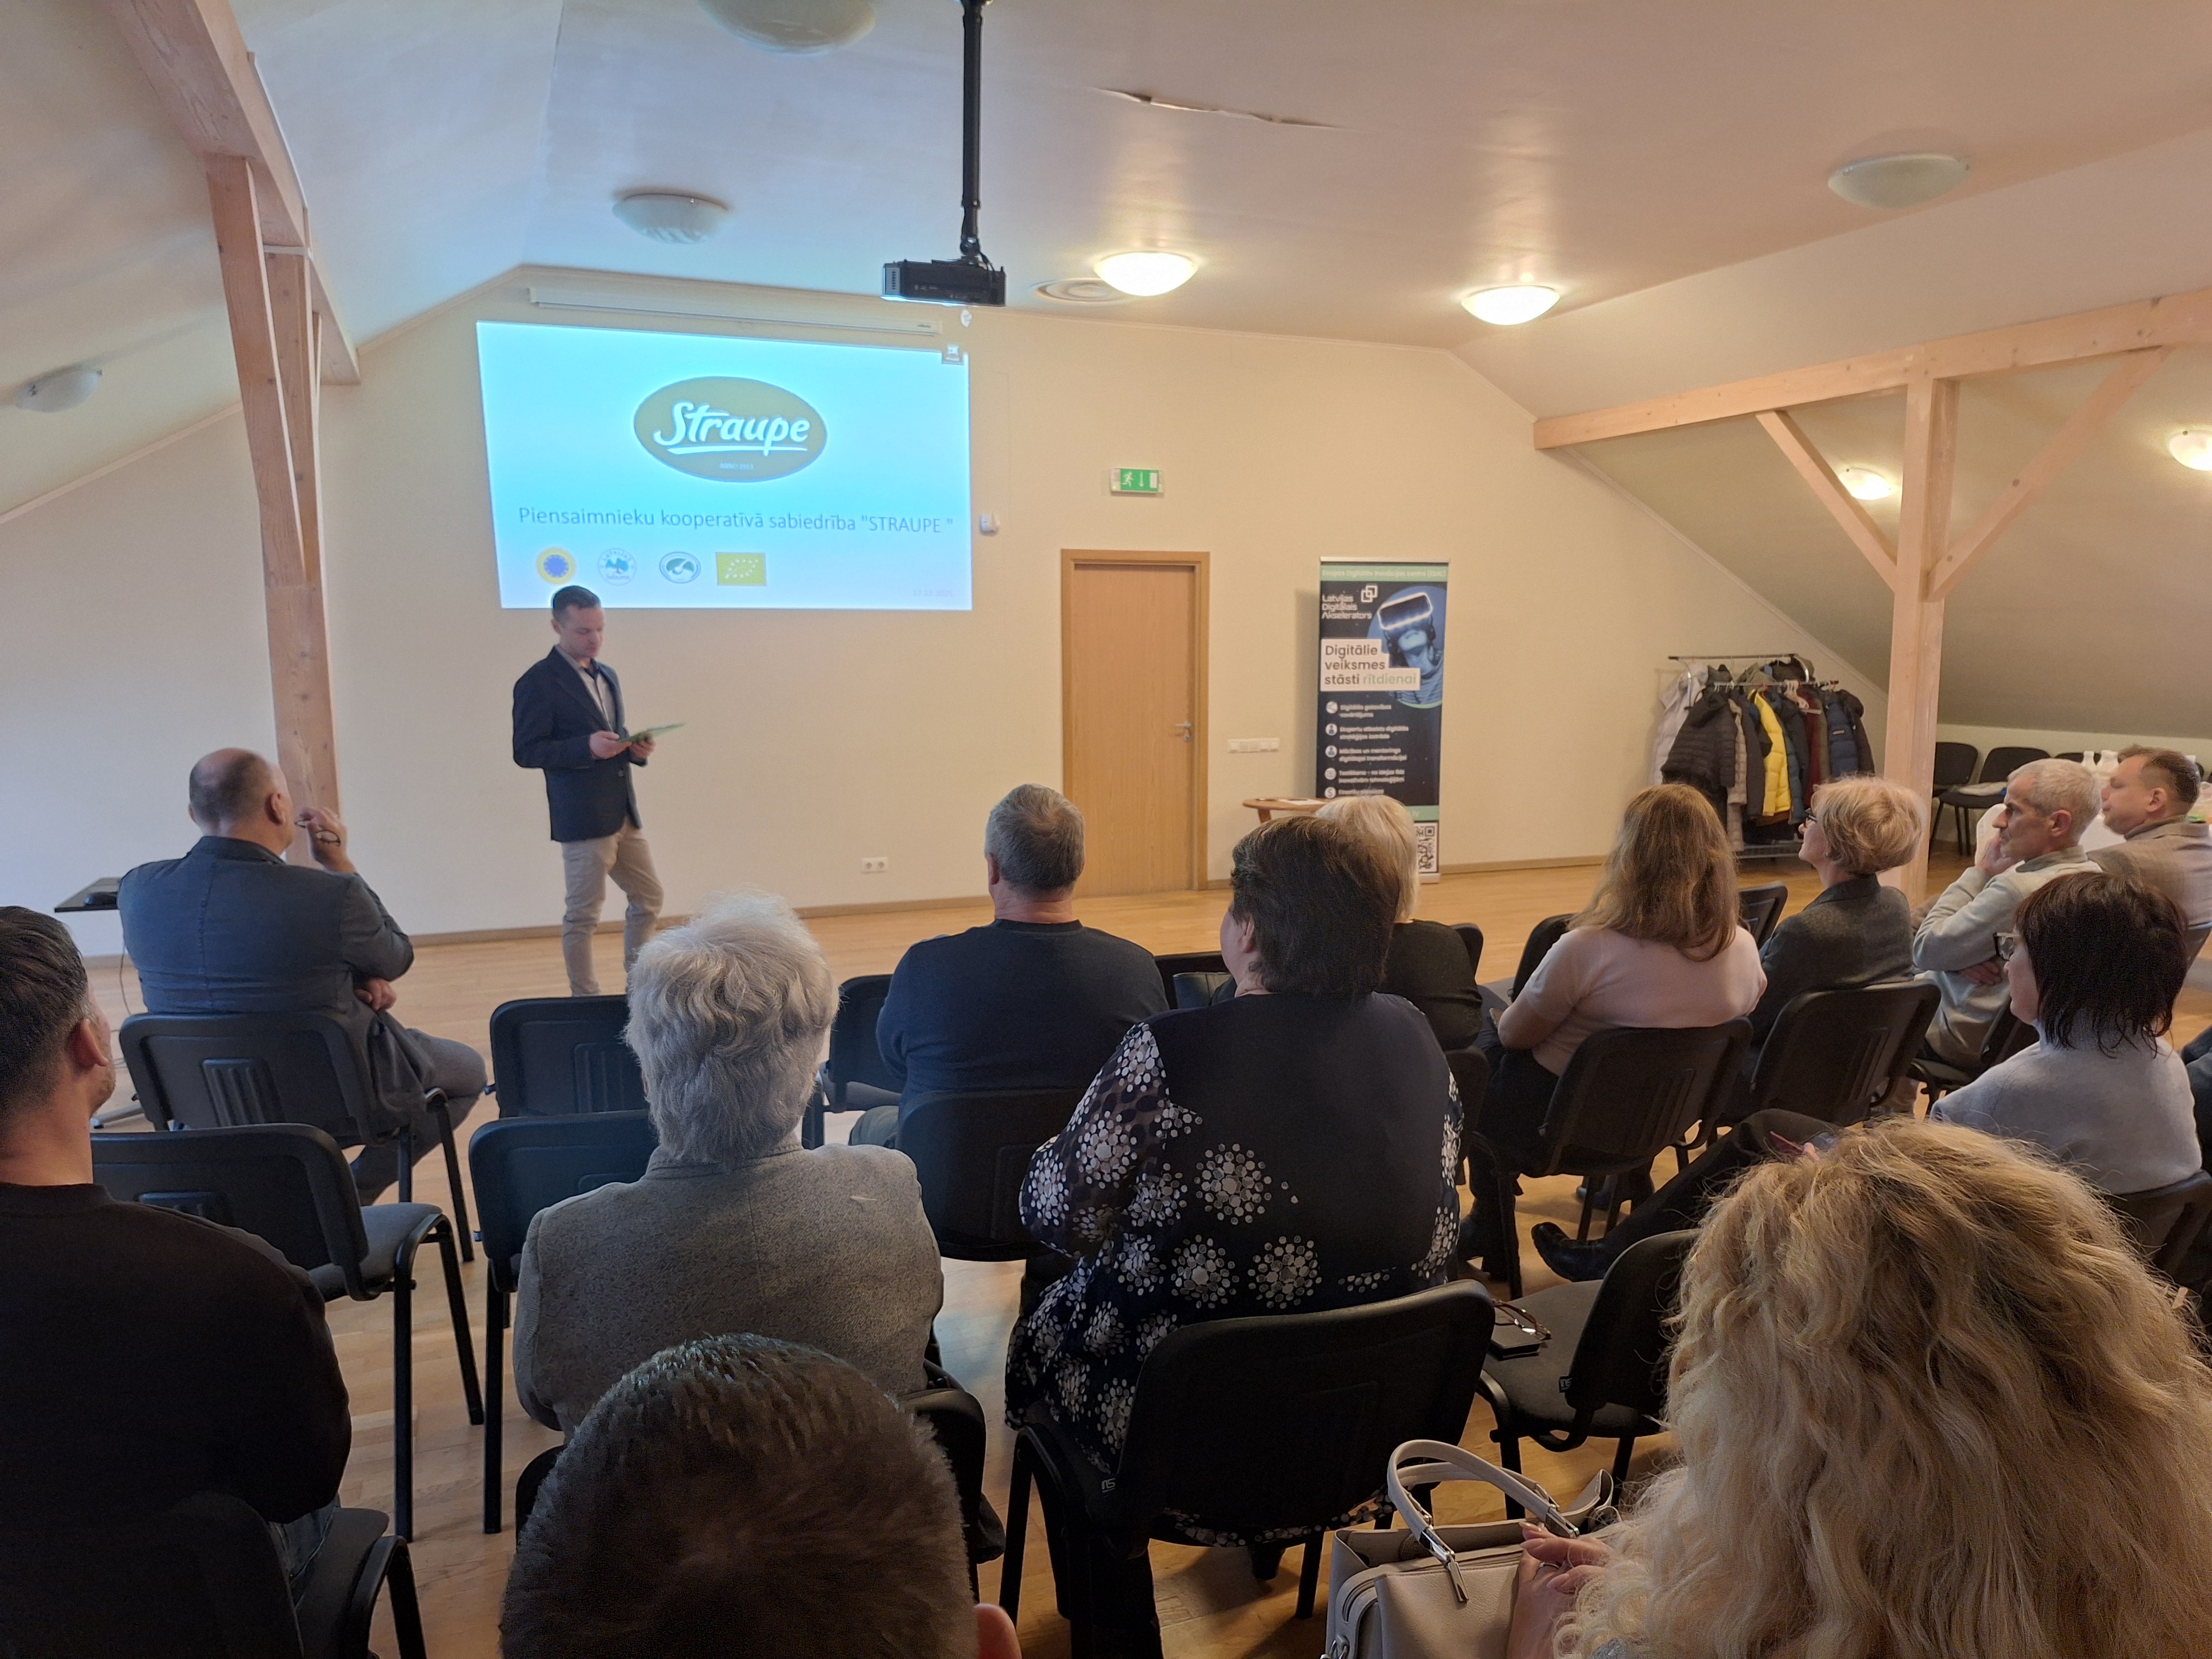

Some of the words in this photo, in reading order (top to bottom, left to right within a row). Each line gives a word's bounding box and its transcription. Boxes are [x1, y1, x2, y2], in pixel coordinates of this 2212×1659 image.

[652, 401, 811, 456] Straupe
[519, 507, 654, 525] Piensaimnieku
[661, 509, 764, 529] kooperatīvā
[769, 512, 856, 530] sabiedrība
[861, 515, 941, 533] "STRAUPE
[1322, 594, 1354, 604] Latvijas
[1321, 612, 1373, 620] Akselerators
[1325, 644, 1378, 659] Digitālie
[1324, 659, 1386, 670] veiksmes
[1324, 674, 1360, 685] stāsti
[1363, 673, 1417, 685] rītdienai
